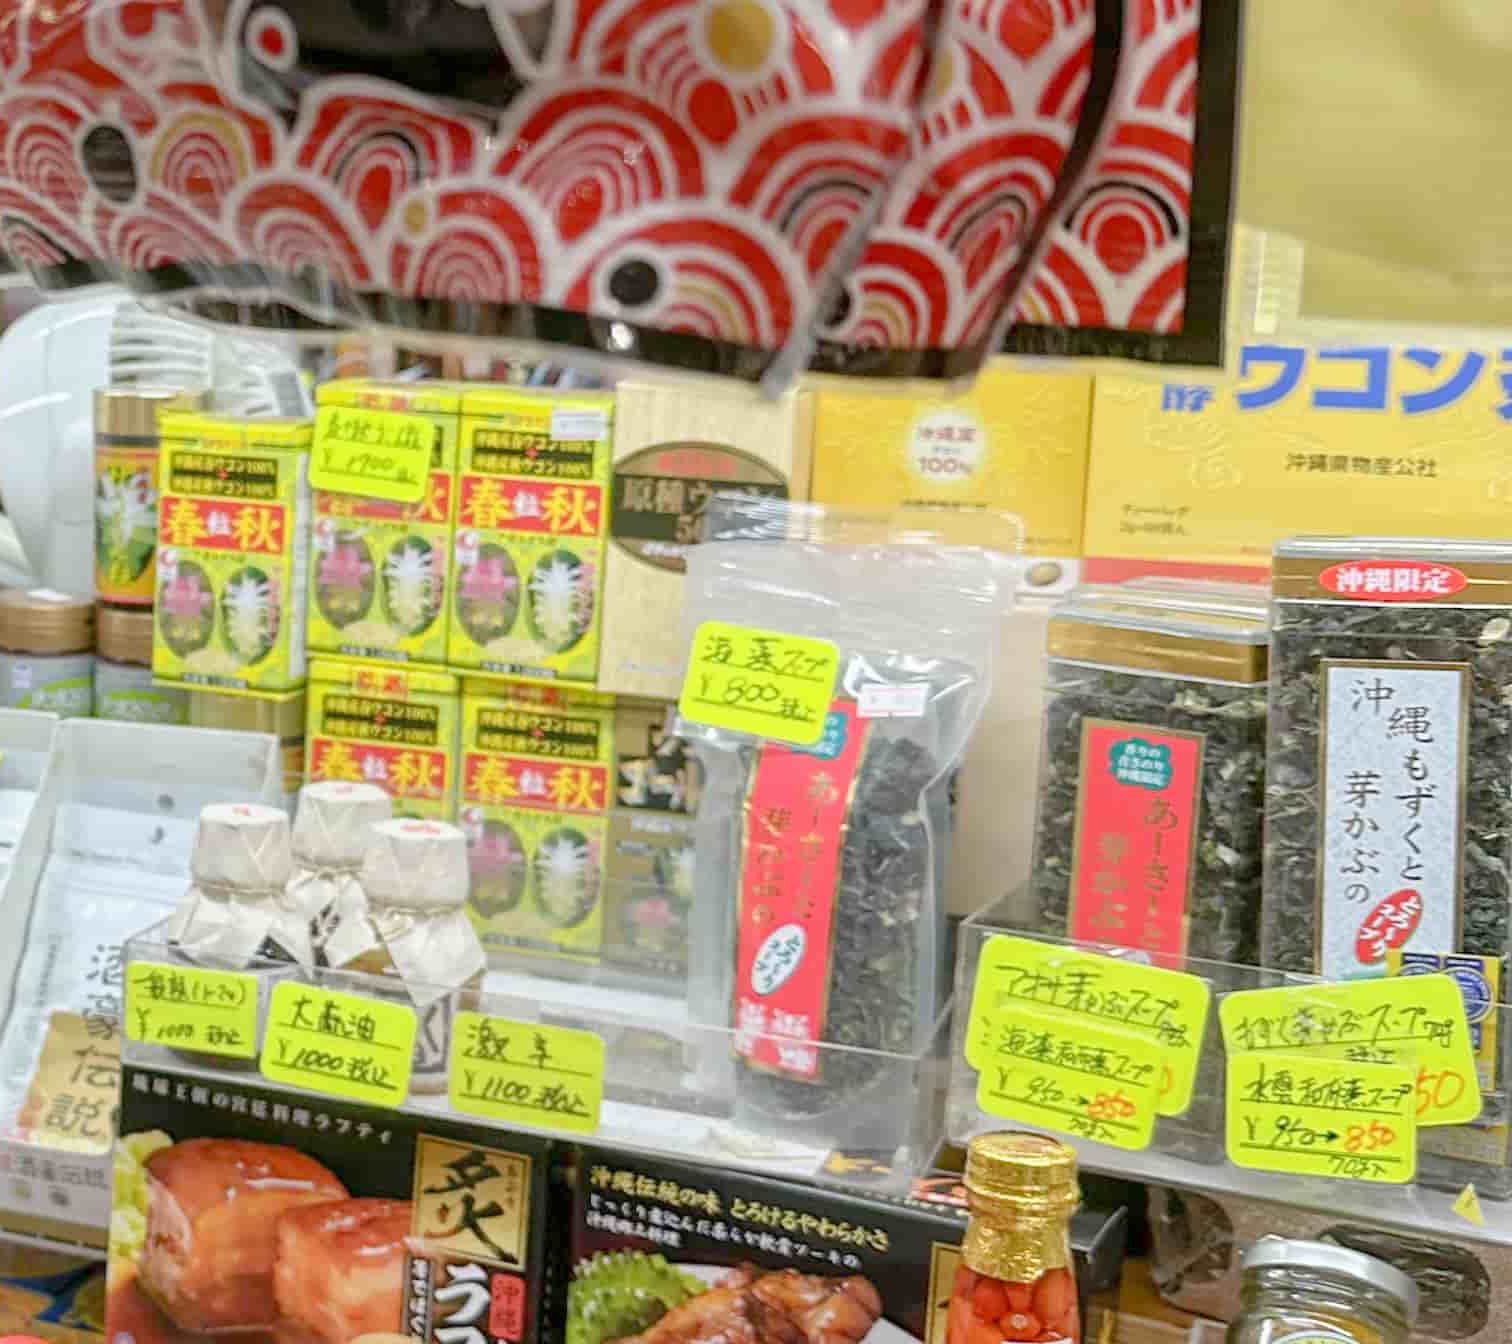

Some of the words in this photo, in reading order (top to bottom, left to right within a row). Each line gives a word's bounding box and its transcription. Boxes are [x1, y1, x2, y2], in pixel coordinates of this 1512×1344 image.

[1285, 451, 1439, 480] 沖縄県物産公社
[1335, 567, 1452, 594] 沖縄限定
[725, 678, 780, 706] 800
[1339, 769, 1382, 904] 芽かぶの
[291, 1044, 345, 1071] 1000
[482, 1071, 531, 1101] 1100
[1343, 1119, 1397, 1152] 850
[730, 1197, 889, 1252] とろけるやわらかさ
